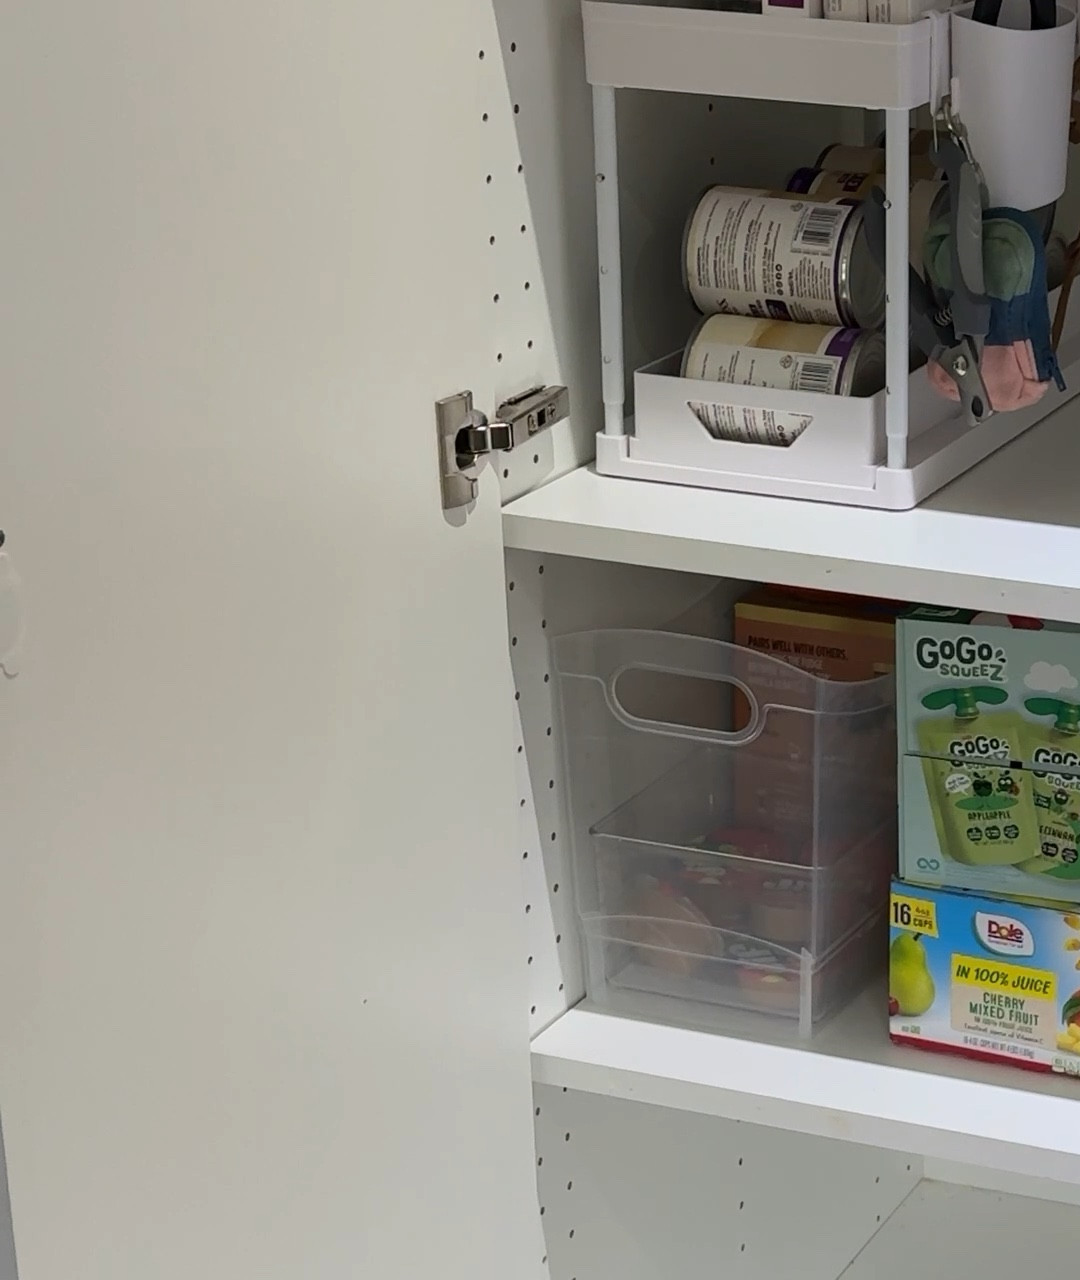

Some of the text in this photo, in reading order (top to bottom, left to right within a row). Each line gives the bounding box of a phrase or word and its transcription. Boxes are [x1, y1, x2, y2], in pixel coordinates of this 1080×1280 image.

[747, 635, 849, 660] PAIRS WELL WITH OTHERS.
[916, 636, 993, 670] GoGo
[939, 663, 1004, 681] SQUEEZ
[892, 901, 912, 926] 16
[912, 917, 933, 930] CUPS
[987, 919, 1024, 940] Dole
[955, 963, 1052, 995] IN 100% JUICE
[969, 1001, 1039, 1026] MIXED FRUIT
[983, 991, 1025, 1011] CHERRY
